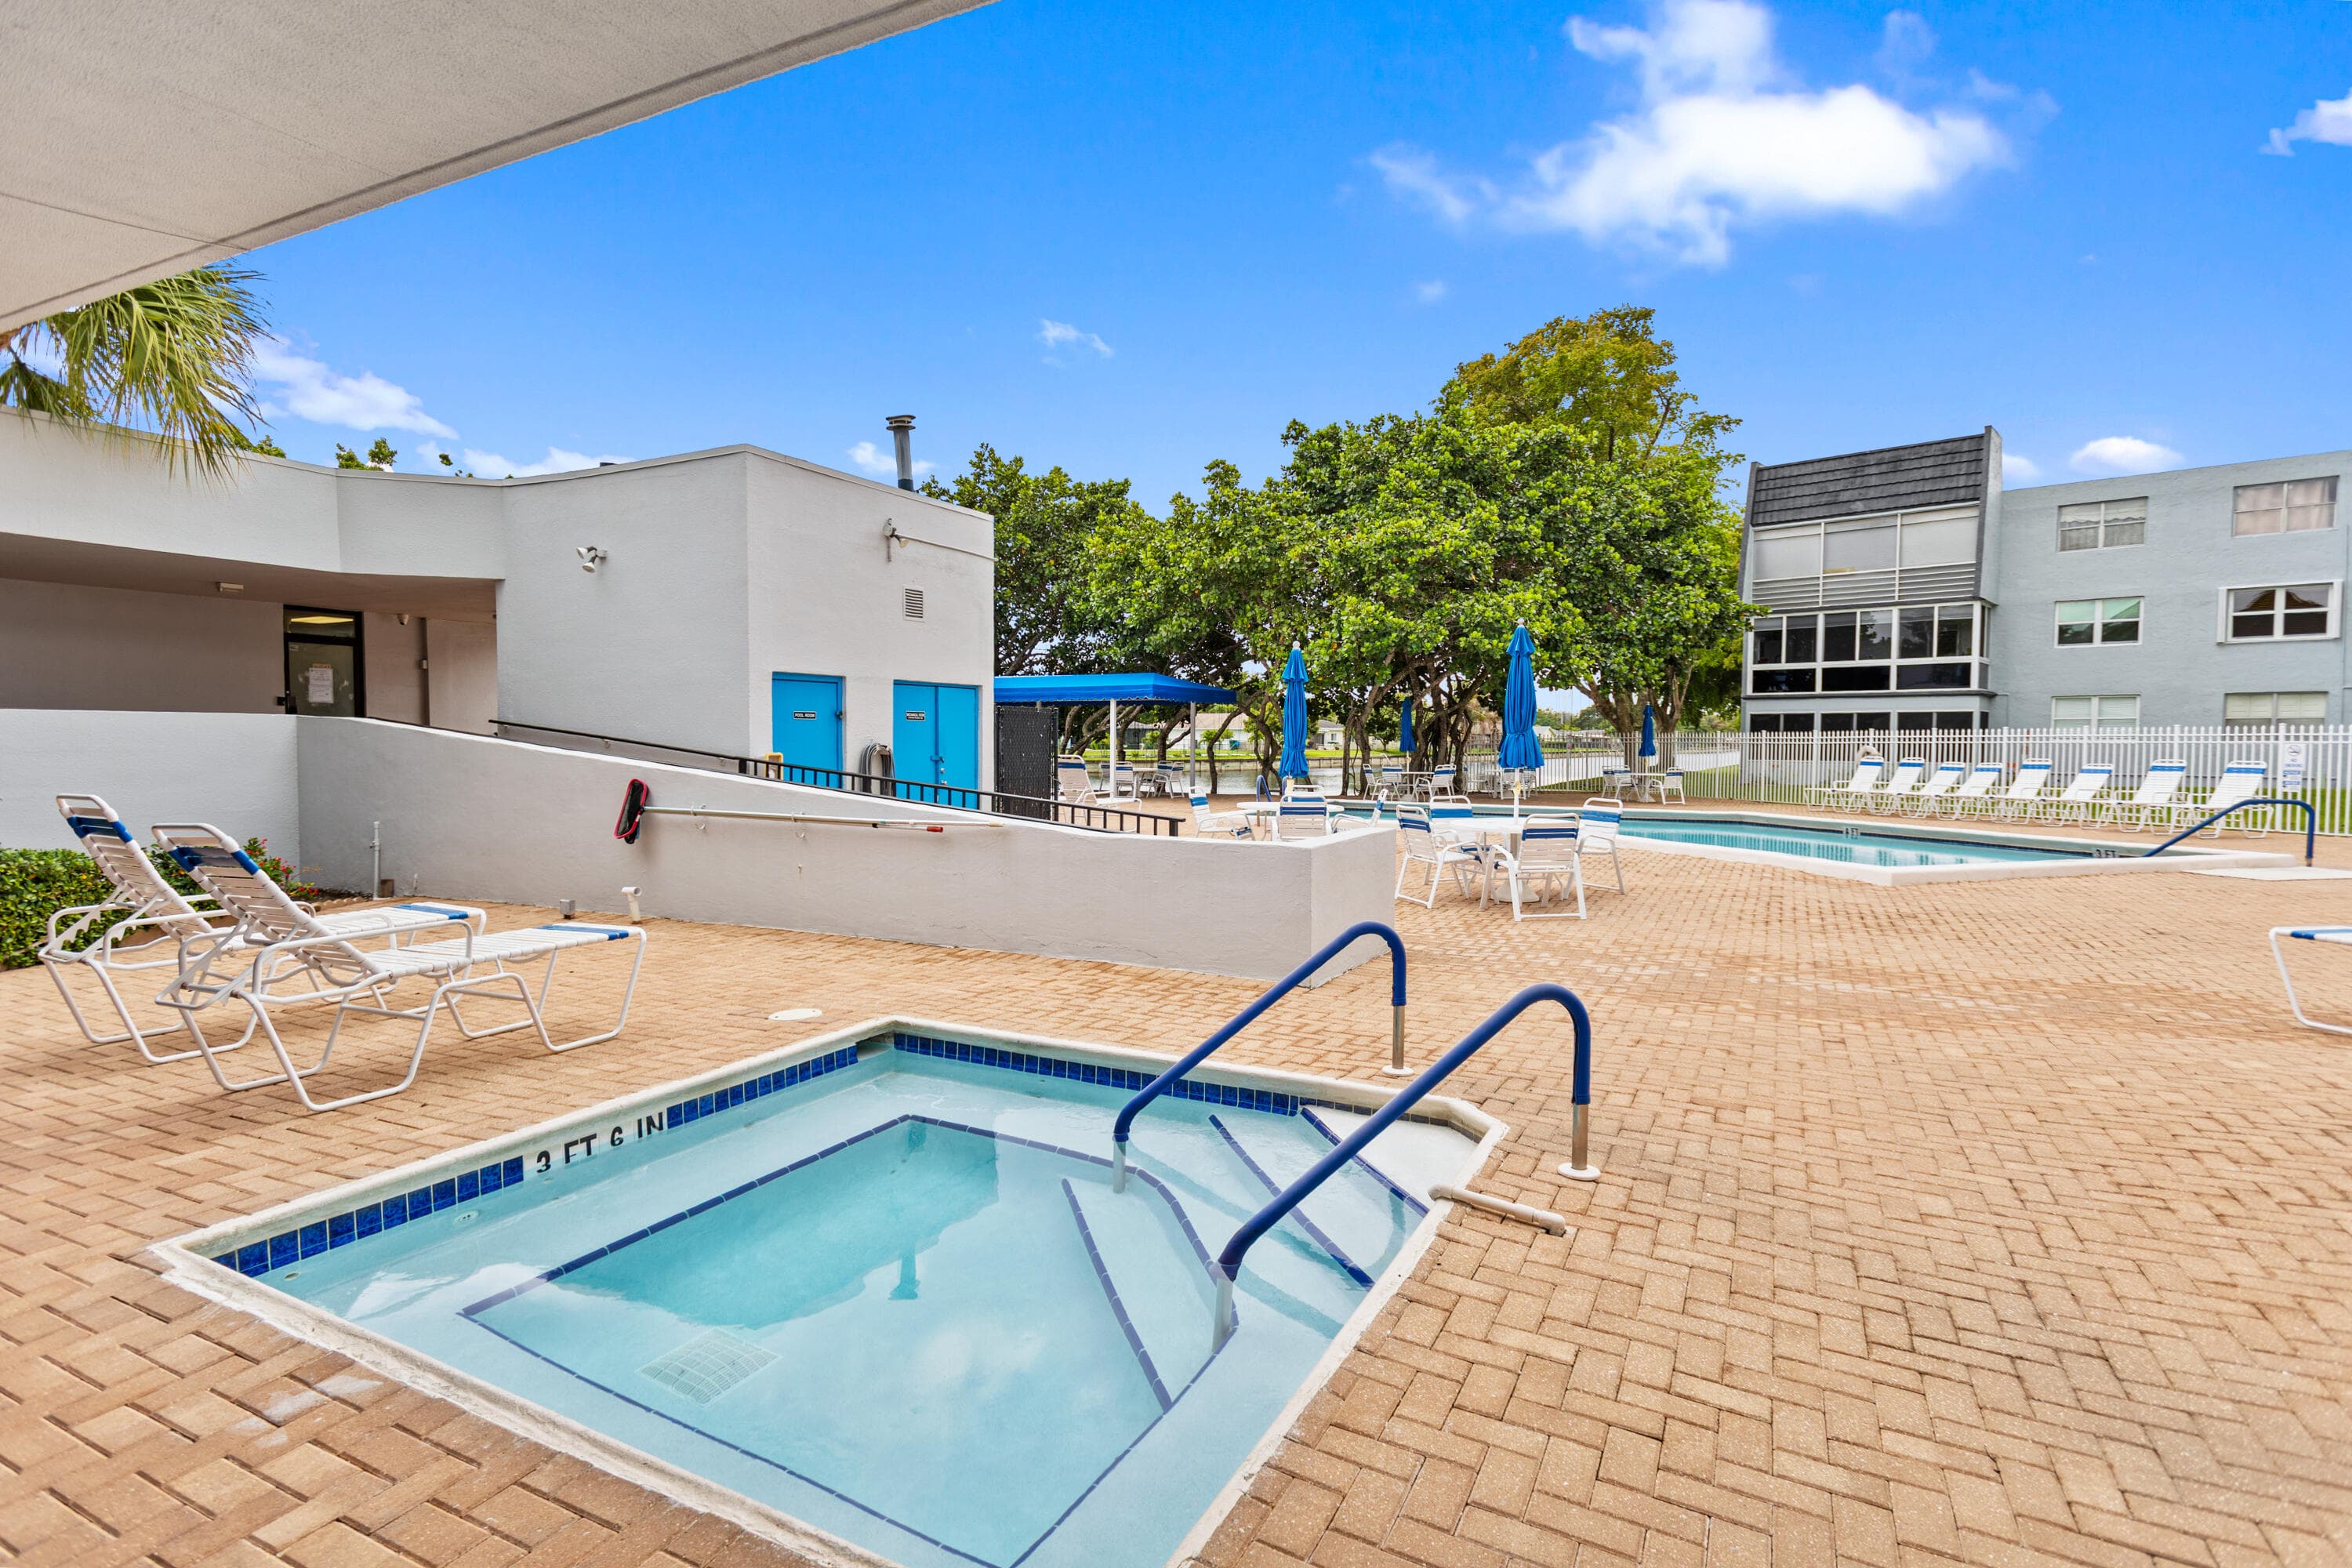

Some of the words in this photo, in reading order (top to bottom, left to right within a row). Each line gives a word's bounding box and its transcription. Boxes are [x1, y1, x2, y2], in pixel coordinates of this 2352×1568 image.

[2105, 850, 2116, 858] FT
[536, 1150, 551, 1174] 3
[564, 1133, 597, 1164] FT
[610, 1126, 624, 1147] 6
[637, 1111, 664, 1138] IN
